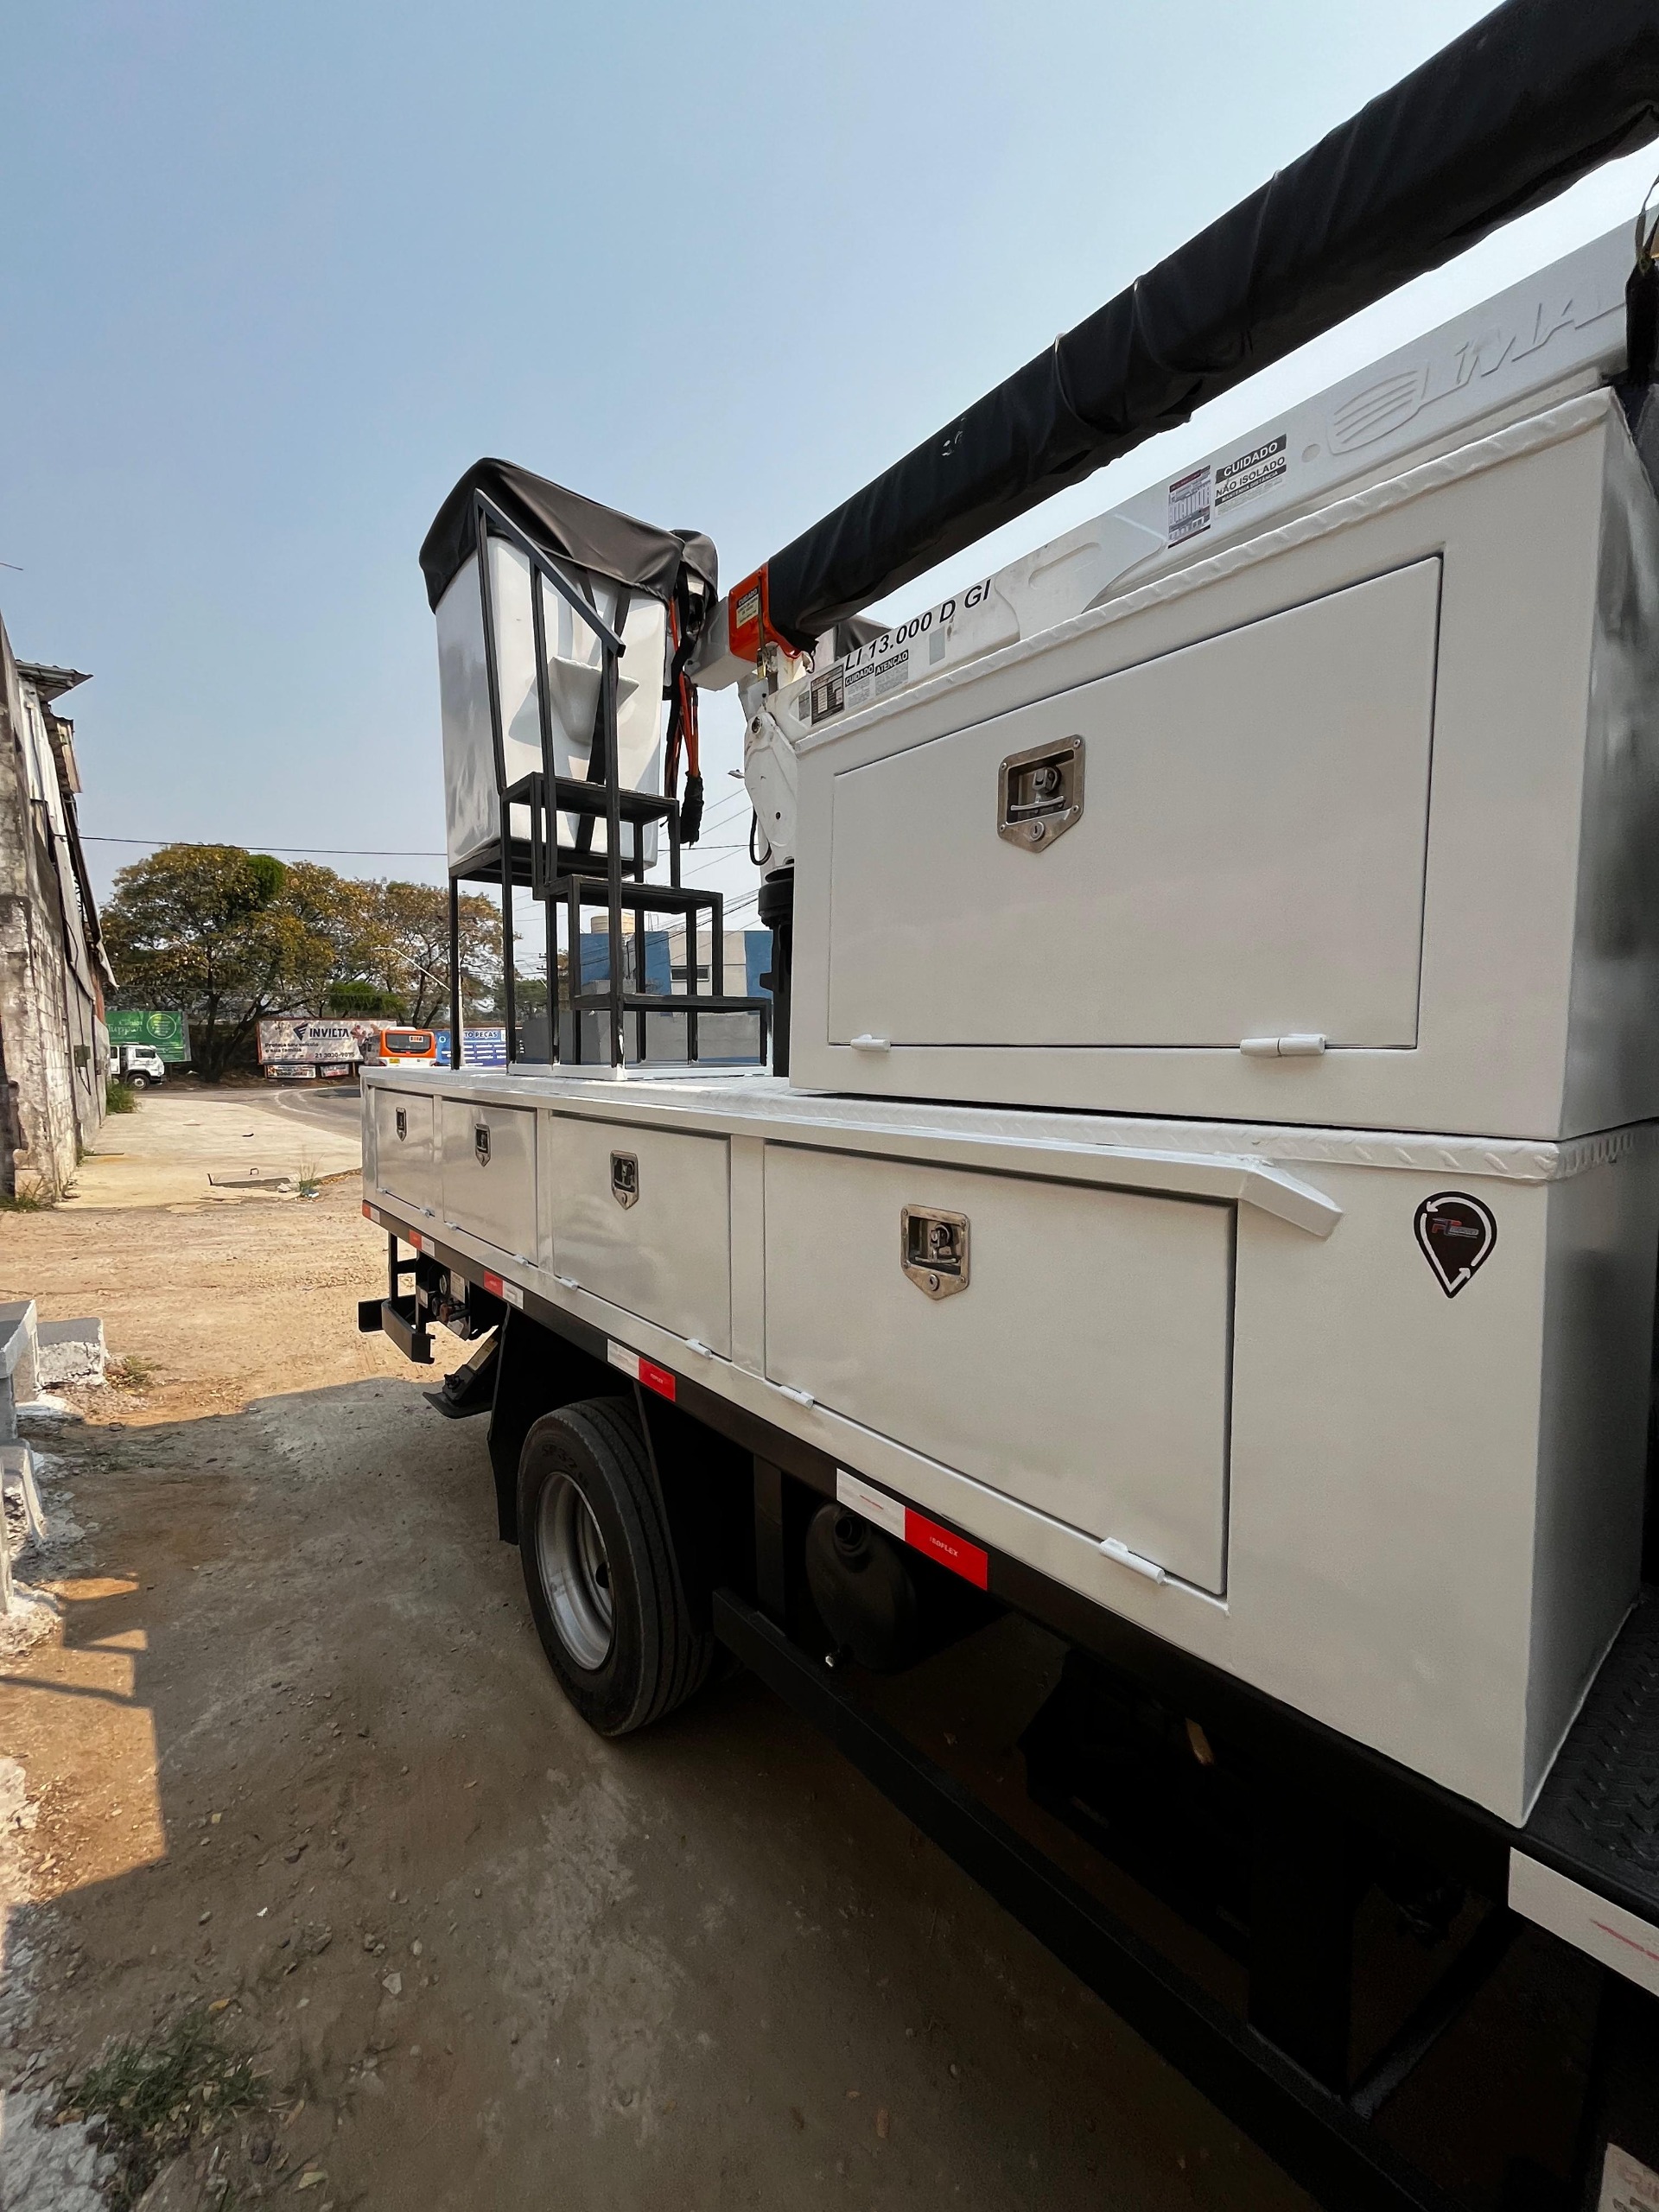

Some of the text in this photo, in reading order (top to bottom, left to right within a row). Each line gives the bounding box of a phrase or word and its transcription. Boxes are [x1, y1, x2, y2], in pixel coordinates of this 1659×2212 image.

[1216, 480, 1236, 498] NÃO
[1239, 456, 1285, 486] ISOLADO
[1224, 442, 1278, 477] CUIDADO
[844, 578, 991, 672] LI 13.000 D GI
[845, 664, 874, 686] CUIDADO
[309, 1027, 350, 1038] INVICTA
